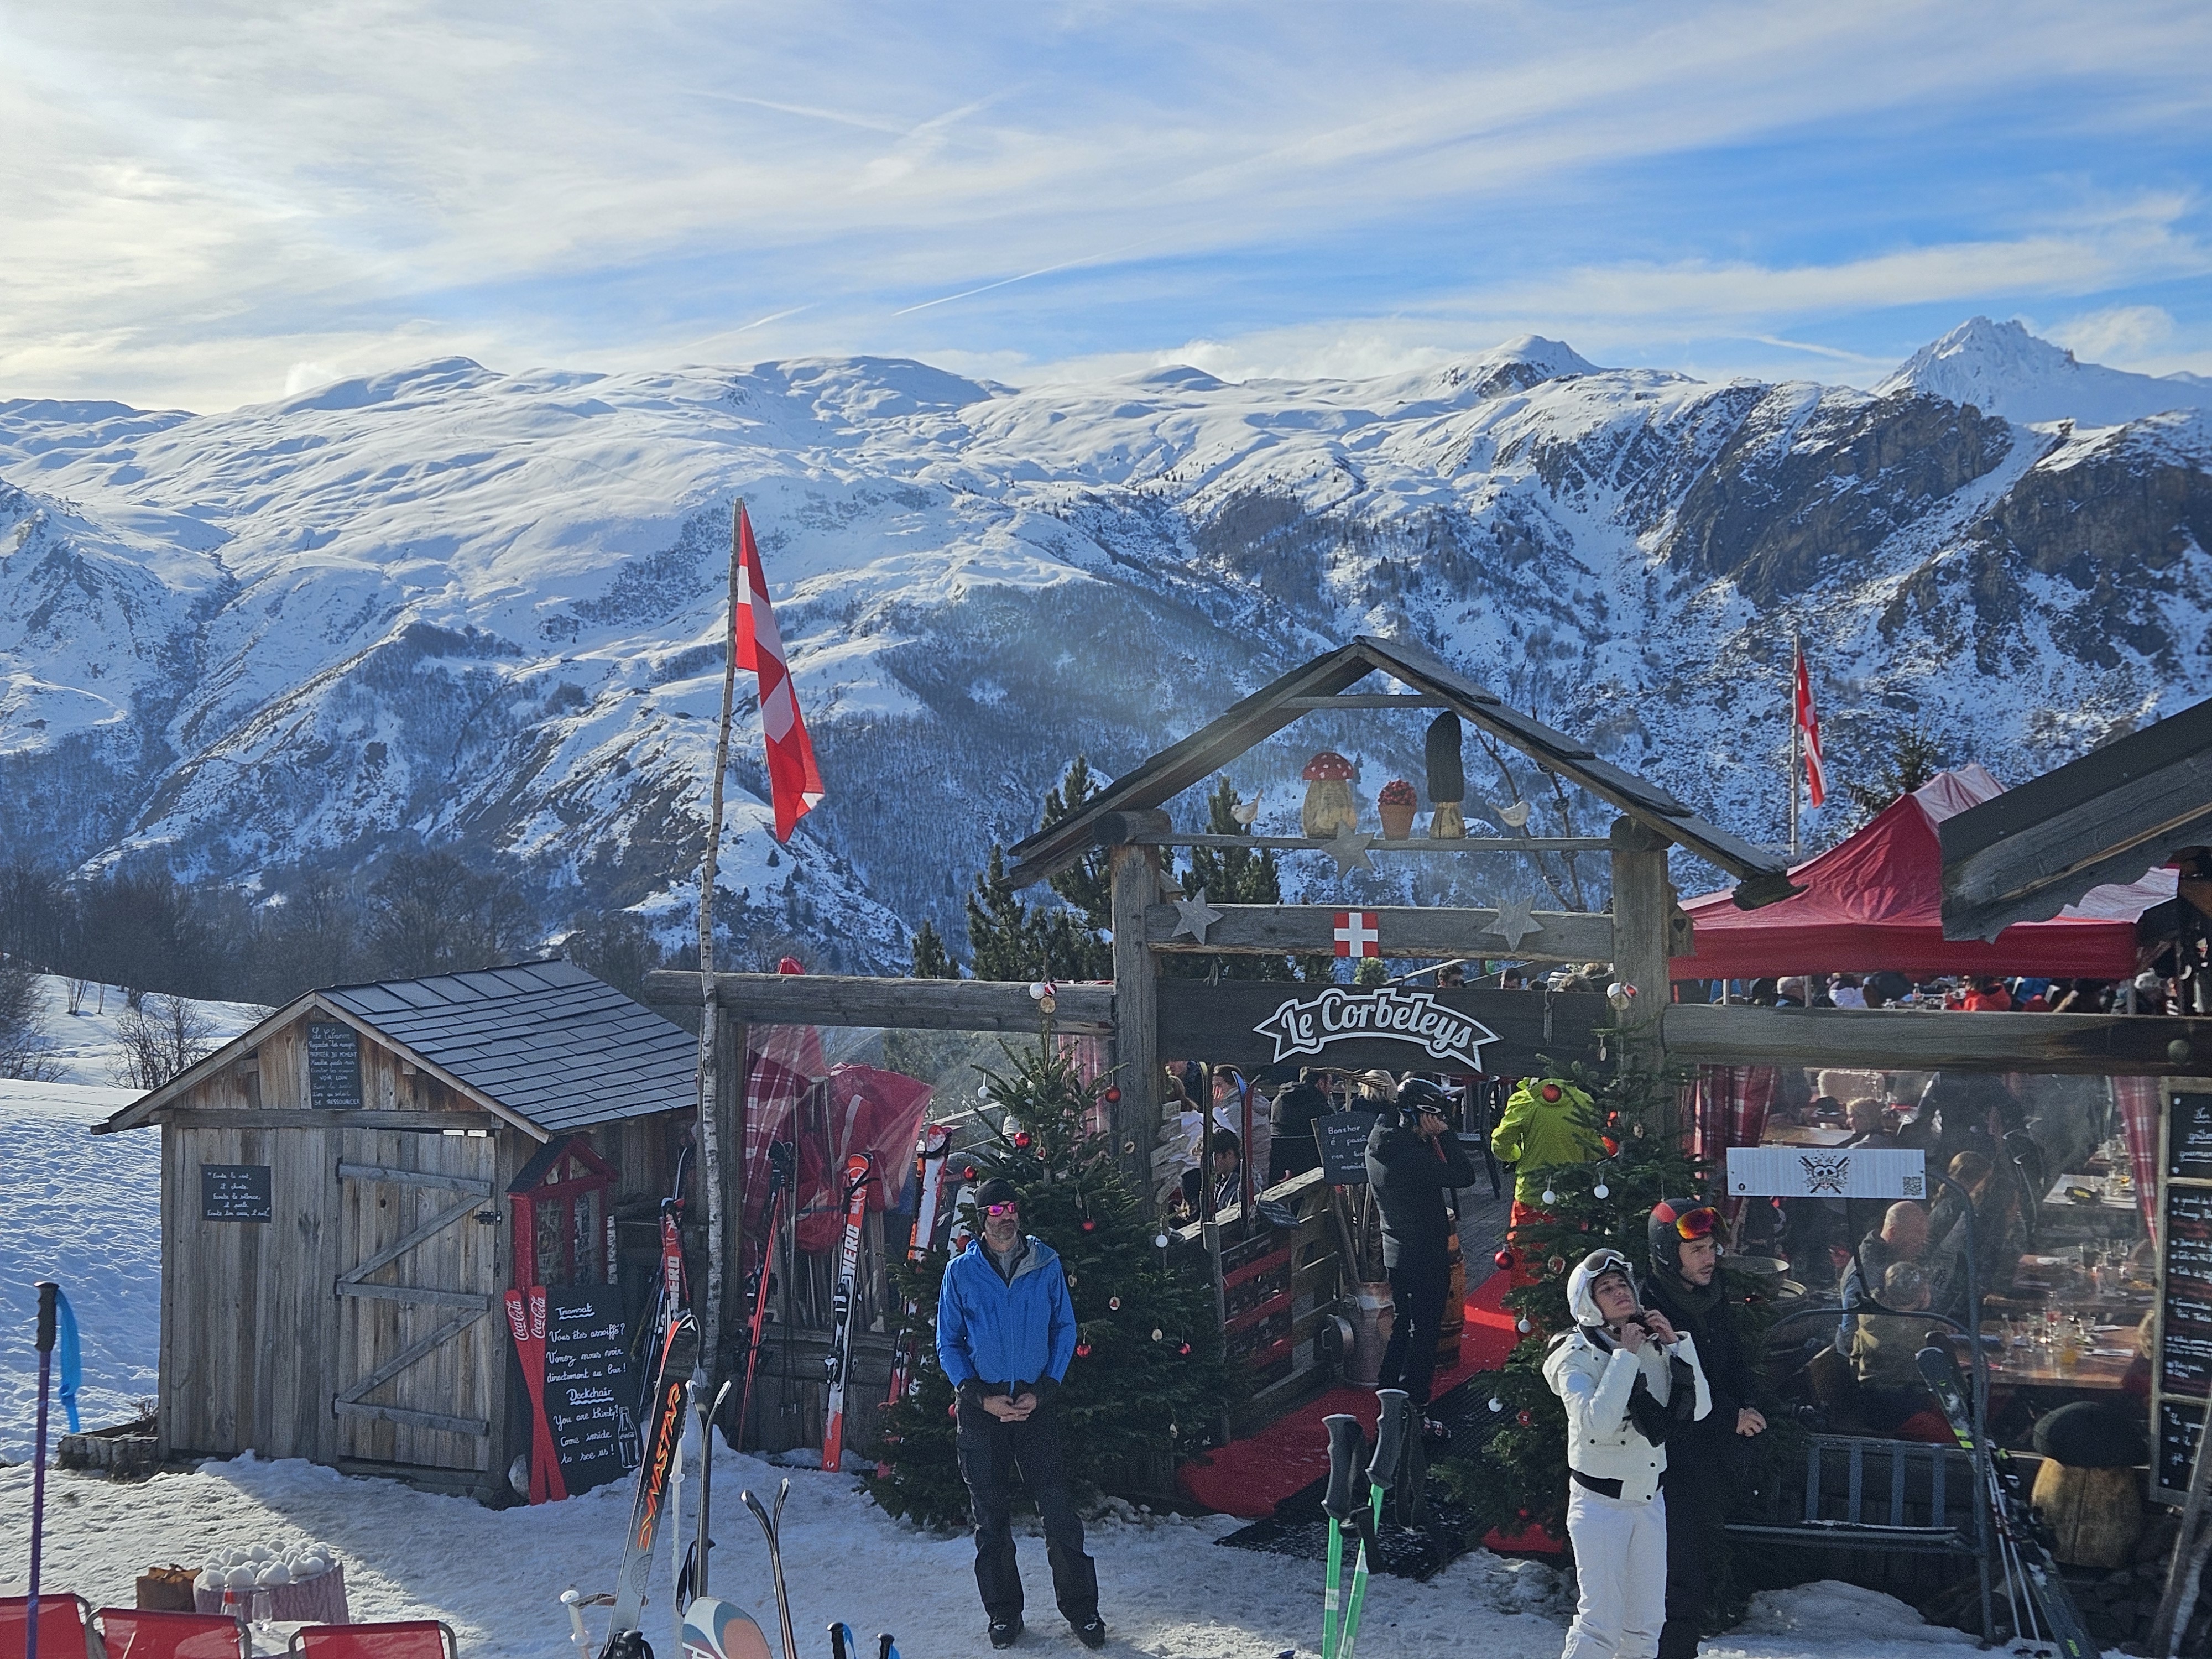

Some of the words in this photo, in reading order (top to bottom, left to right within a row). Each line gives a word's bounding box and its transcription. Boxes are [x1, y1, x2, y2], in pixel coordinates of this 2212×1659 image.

[1281, 1009, 1317, 1046] Le
[1322, 995, 1473, 1050] Corbeleys
[555, 1302, 593, 1316] Transat
[581, 1350, 602, 1361] nous
[604, 1348, 623, 1358] voir
[547, 1370, 590, 1384] directement
[566, 1387, 612, 1401] Deckchair
[554, 1415, 572, 1432] You
[575, 1413, 590, 1423] are
[560, 1436, 580, 1447] Come
[585, 1430, 612, 1442] inside
[560, 1454, 572, 1464] to
[580, 1450, 596, 1460] see
[638, 1382, 681, 1552] DYNASTAR
